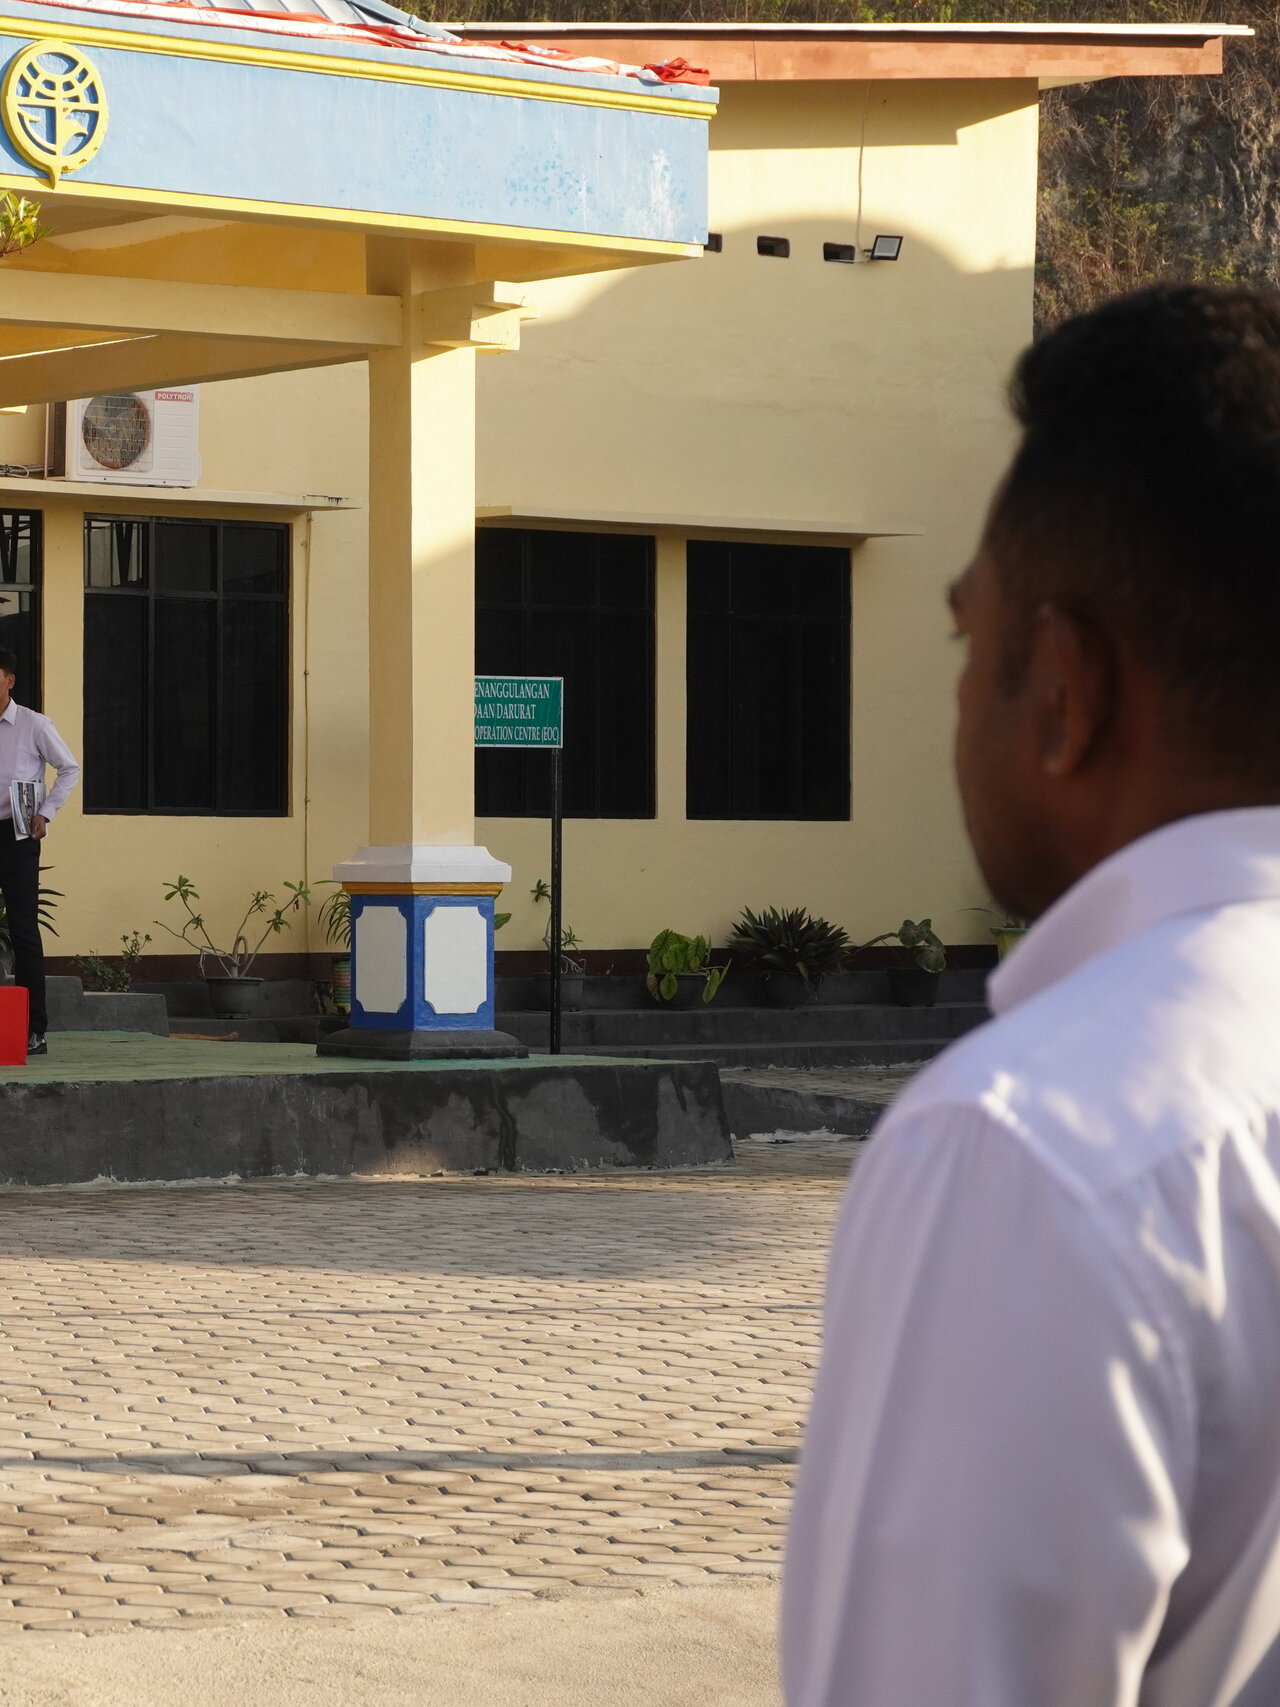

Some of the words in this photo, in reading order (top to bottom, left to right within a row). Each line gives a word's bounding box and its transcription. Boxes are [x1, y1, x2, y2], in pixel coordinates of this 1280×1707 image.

[497, 703, 536, 719] DARURAT
[475, 726, 513, 740] OPERATION
[514, 726, 540, 741] CENTRE
[541, 726, 559, 744] (EOC)
